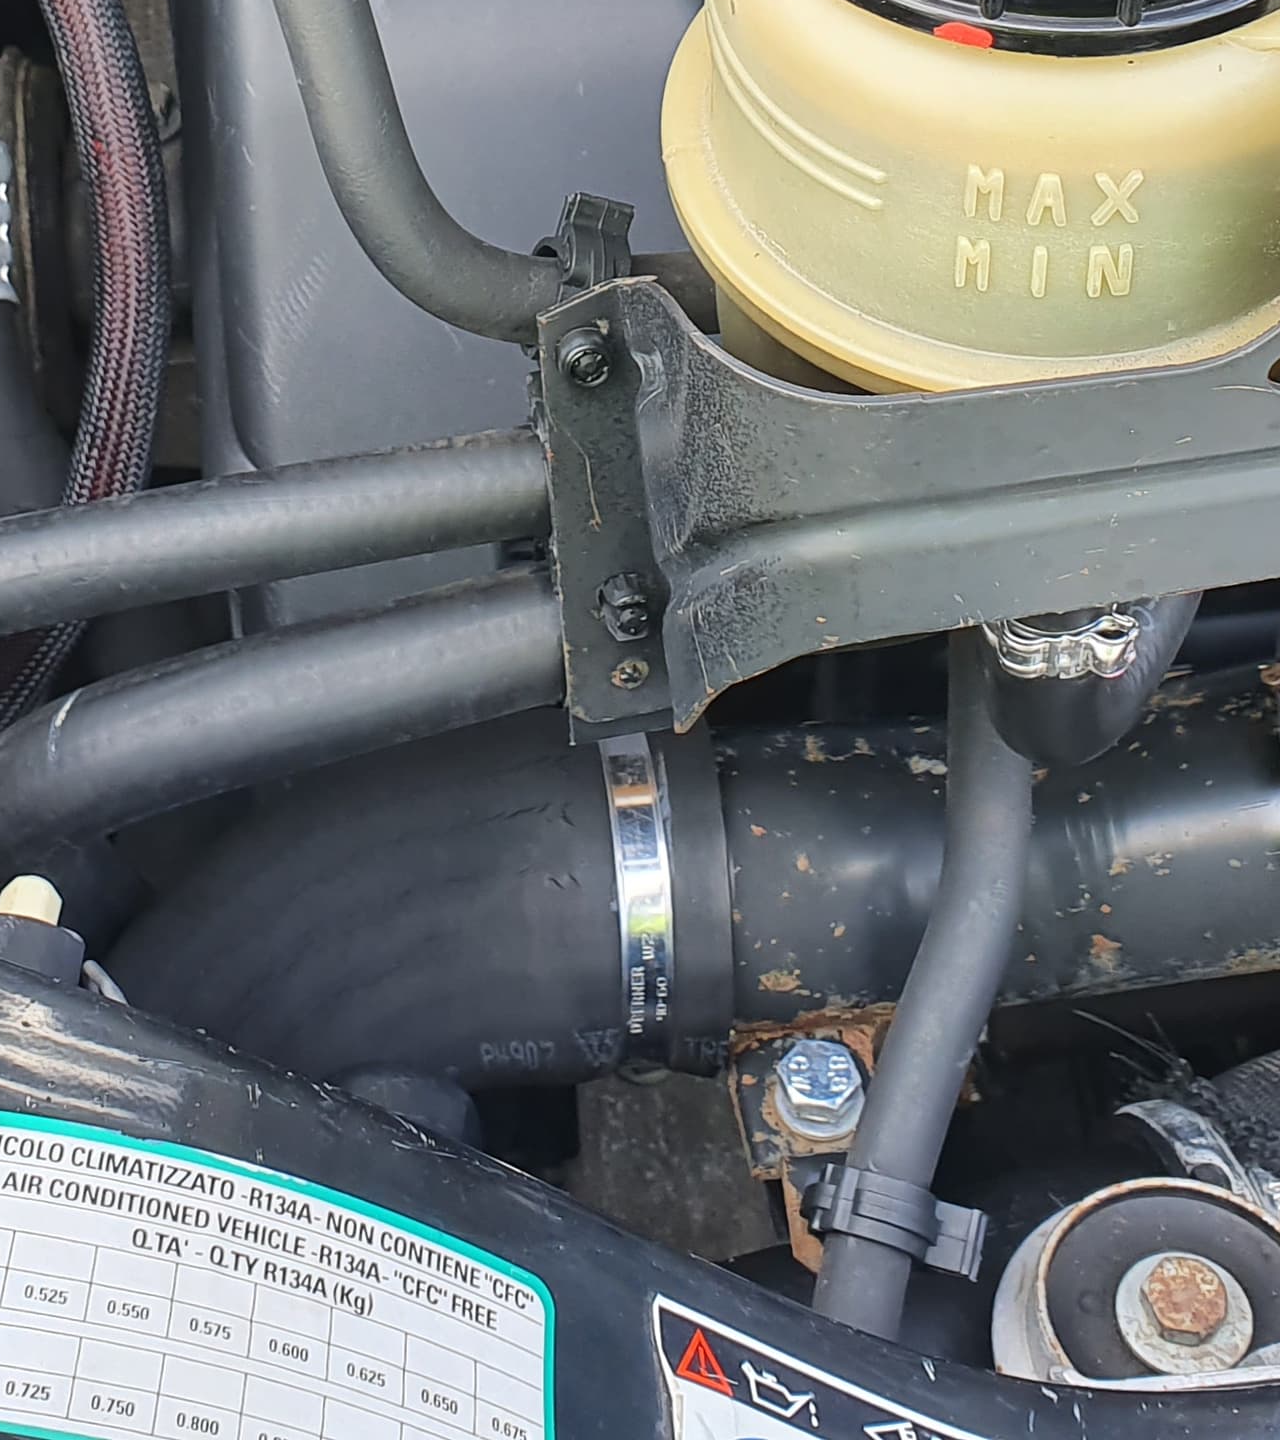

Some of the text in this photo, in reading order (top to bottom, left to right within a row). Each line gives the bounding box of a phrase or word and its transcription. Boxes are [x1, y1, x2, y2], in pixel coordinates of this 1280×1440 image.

[964, 164, 1145, 227] MAX
[954, 235, 1134, 298] MIN
[2, 1172, 41, 1195] AIR
[49, 1178, 210, 1229] CONDITIONED
[218, 1213, 307, 1257] VEHICLE
[394, 1269, 448, 1306] "CFC"
[452, 1294, 498, 1331] FREE
[71, 1147, 234, 1200] CLIMATIZZATO
[326, 1211, 374, 1245] NON
[380, 1231, 480, 1288] CONTIENE
[485, 1272, 534, 1310] "CFC"
[264, 1262, 328, 1299] R134A
[333, 1282, 374, 1317] (Kg)
[24, 1285, 68, 1305] 0.525
[107, 1300, 150, 1320] 0.550
[189, 1317, 231, 1340] 0.575
[269, 1339, 309, 1362] 0.600
[347, 1363, 386, 1387] 0.625
[421, 1389, 458, 1414] 0.650
[492, 1417, 527, 1440] 0.675
[5, 1380, 51, 1401] 0.725
[90, 1394, 135, 1417] 0.750
[176, 1412, 219, 1435] 0.800
